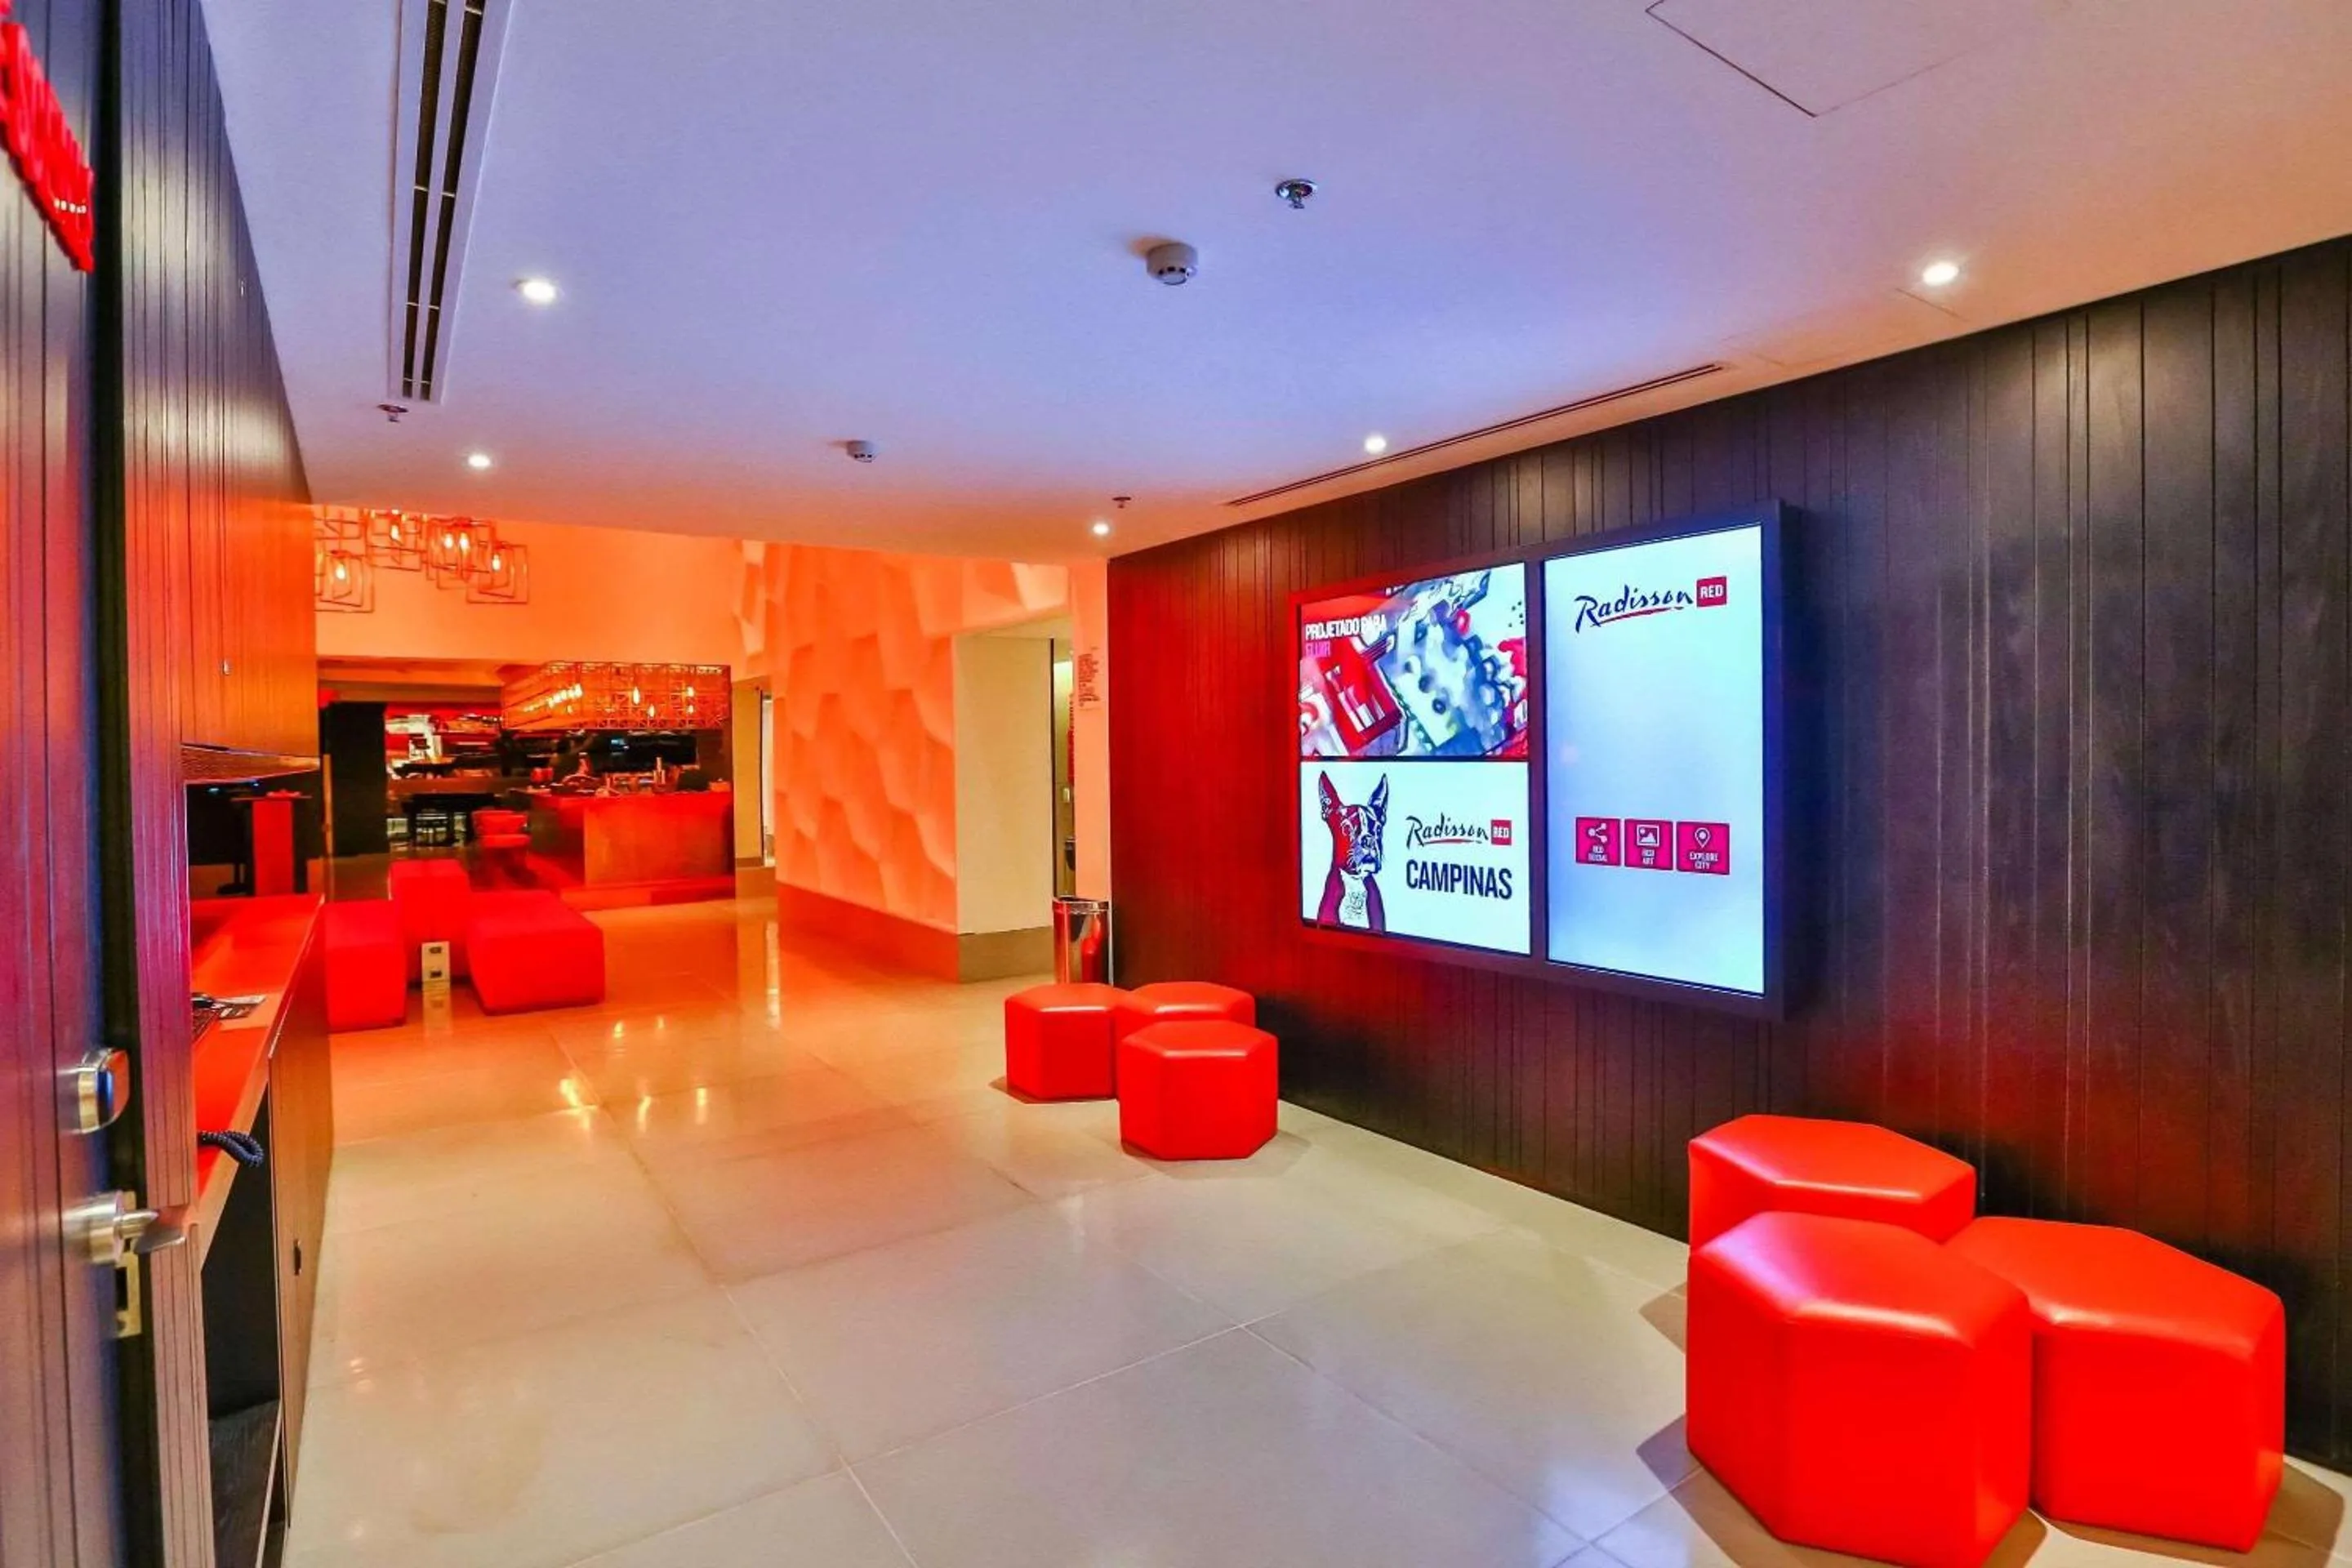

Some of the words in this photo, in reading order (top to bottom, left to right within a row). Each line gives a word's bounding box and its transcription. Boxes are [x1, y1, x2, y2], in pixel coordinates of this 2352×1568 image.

[1575, 584, 1693, 633] Radisson
[1699, 584, 1724, 599] RED
[1405, 812, 1489, 850] Radisson
[1492, 826, 1509, 838] RED
[1689, 852, 1718, 862] EXPLORE
[1695, 861, 1710, 870] CITY
[1406, 859, 1512, 900] CAMPINAS
